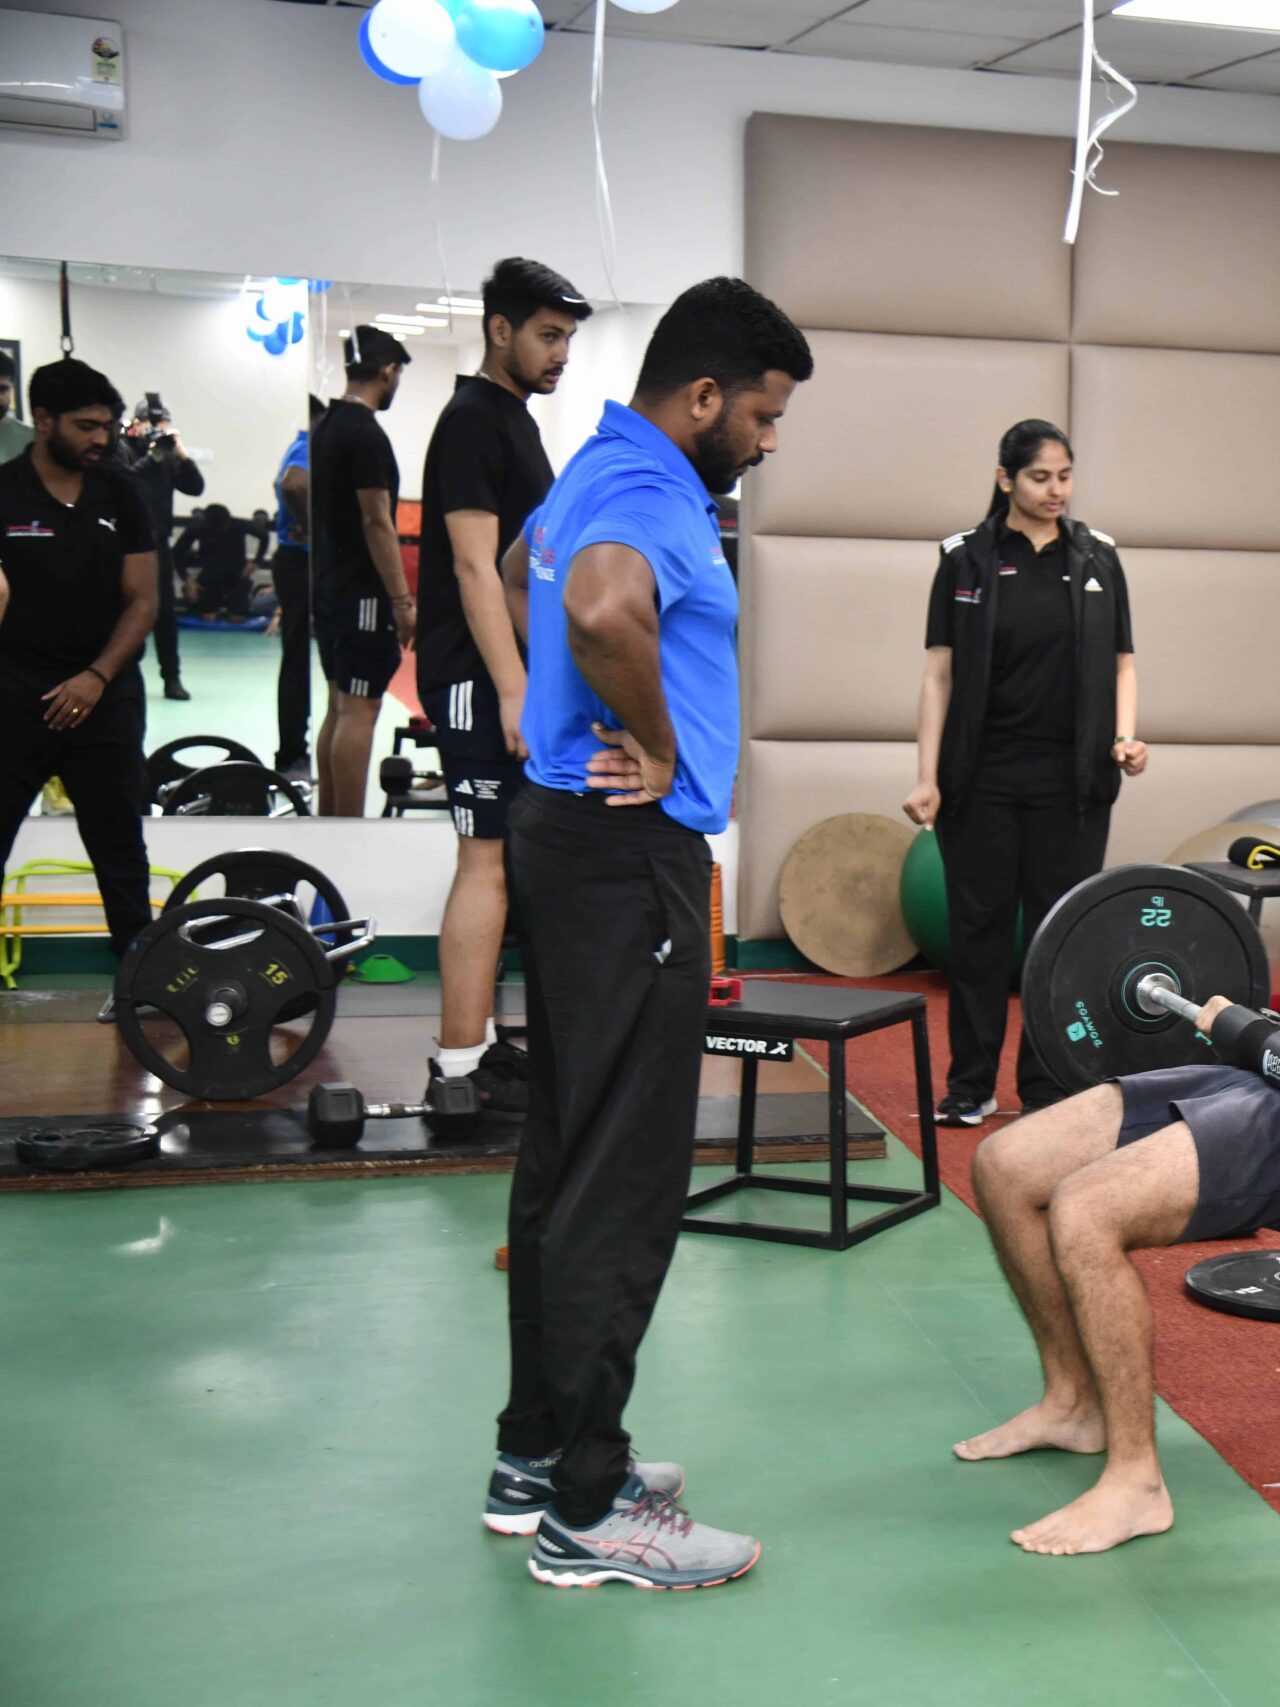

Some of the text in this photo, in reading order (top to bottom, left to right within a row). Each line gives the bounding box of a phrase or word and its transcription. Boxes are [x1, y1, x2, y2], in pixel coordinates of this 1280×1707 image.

[1141, 908, 1171, 927] 22
[263, 963, 289, 984] 15
[1075, 1000, 1103, 1048] DOMYOS
[705, 1035, 768, 1054] VECTOR
